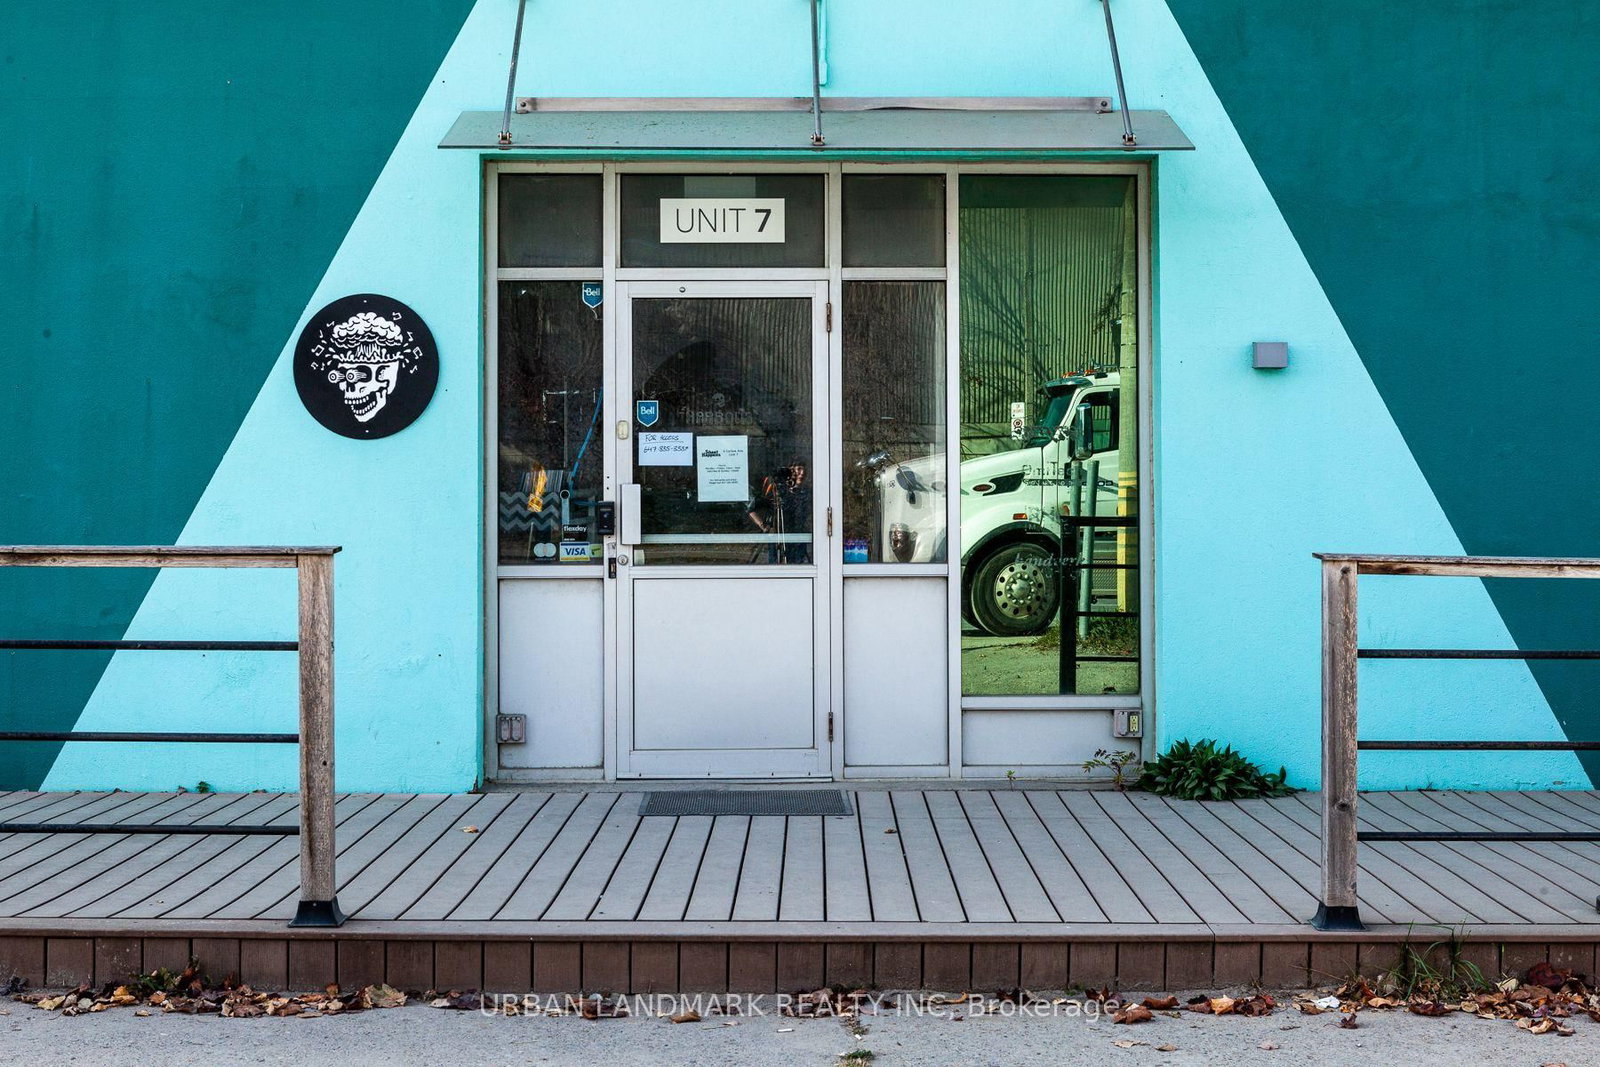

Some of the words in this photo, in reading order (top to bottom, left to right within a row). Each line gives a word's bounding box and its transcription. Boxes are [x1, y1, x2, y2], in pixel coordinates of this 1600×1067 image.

[676, 208, 746, 233] UNIT
[754, 208, 772, 233] 7
[585, 287, 601, 297] Bell
[640, 406, 655, 415] Bell
[565, 547, 586, 556] VISA
